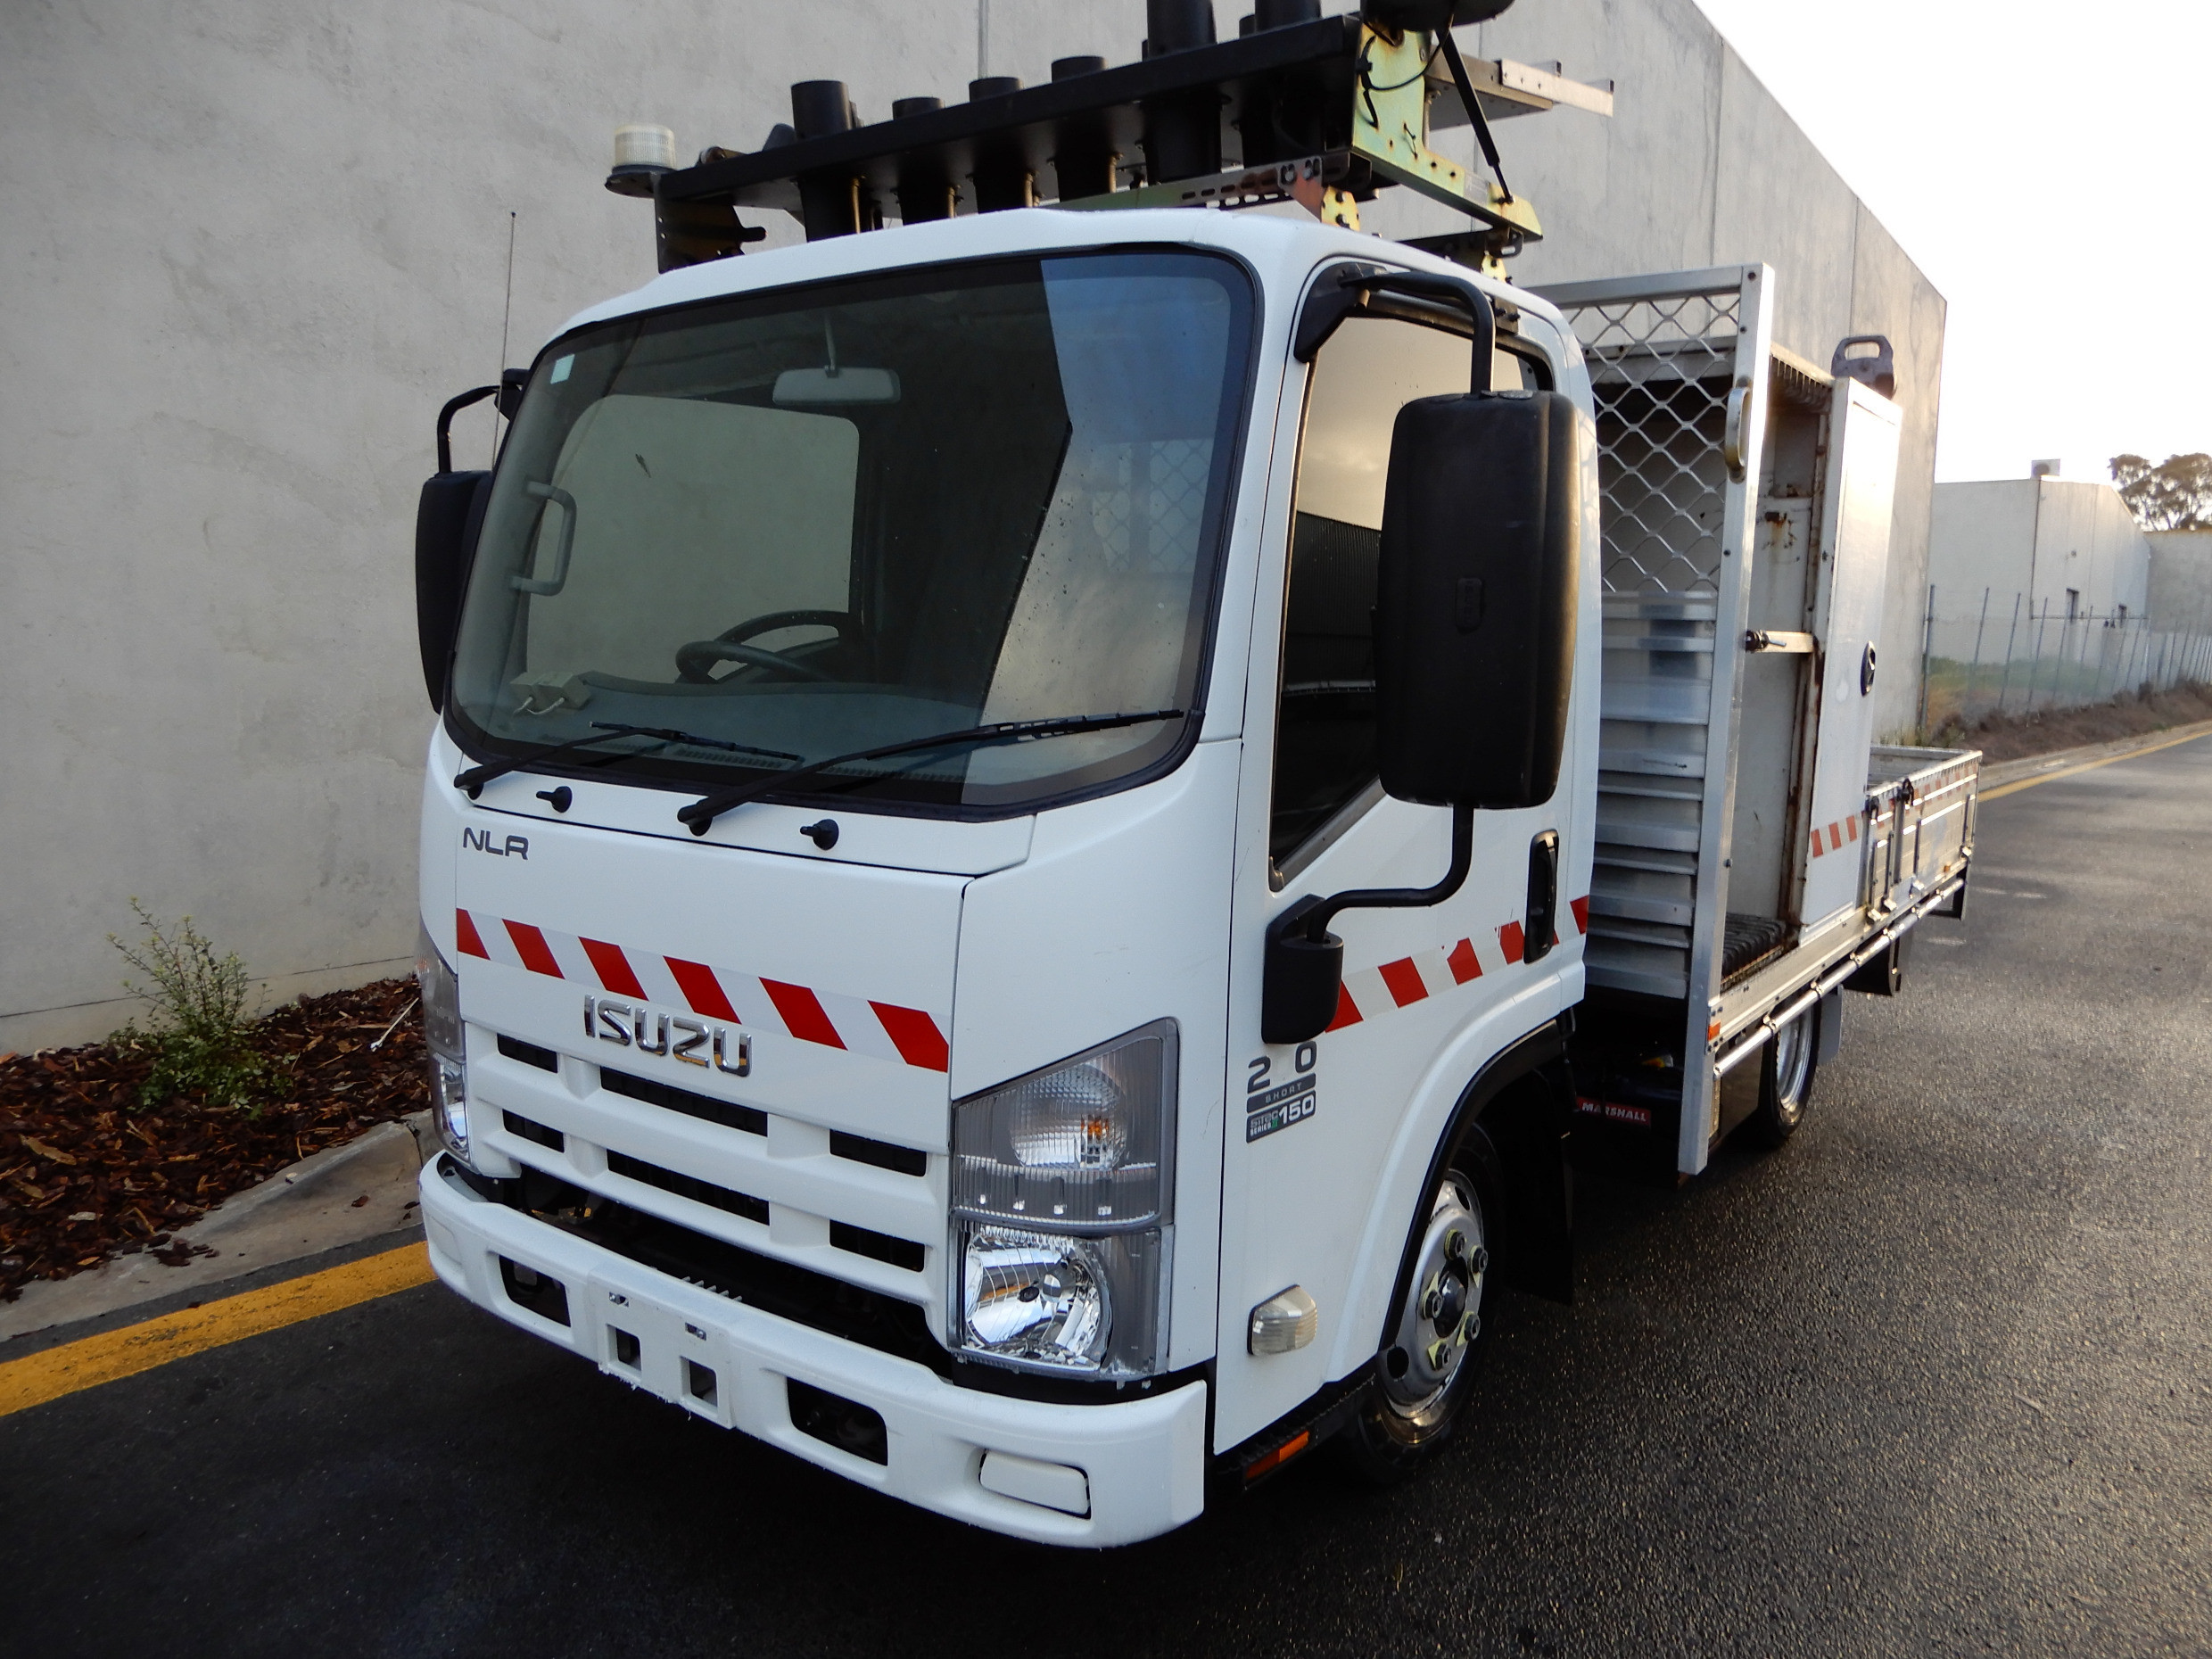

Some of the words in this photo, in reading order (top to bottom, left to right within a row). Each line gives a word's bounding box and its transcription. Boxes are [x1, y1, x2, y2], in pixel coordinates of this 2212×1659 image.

[462, 826, 530, 862] NLR
[583, 994, 753, 1078] ISUZU
[1265, 1081, 1303, 1104] SHORT
[1278, 1094, 1315, 1126] 150
[1581, 1102, 1647, 1122] MARSHALL
